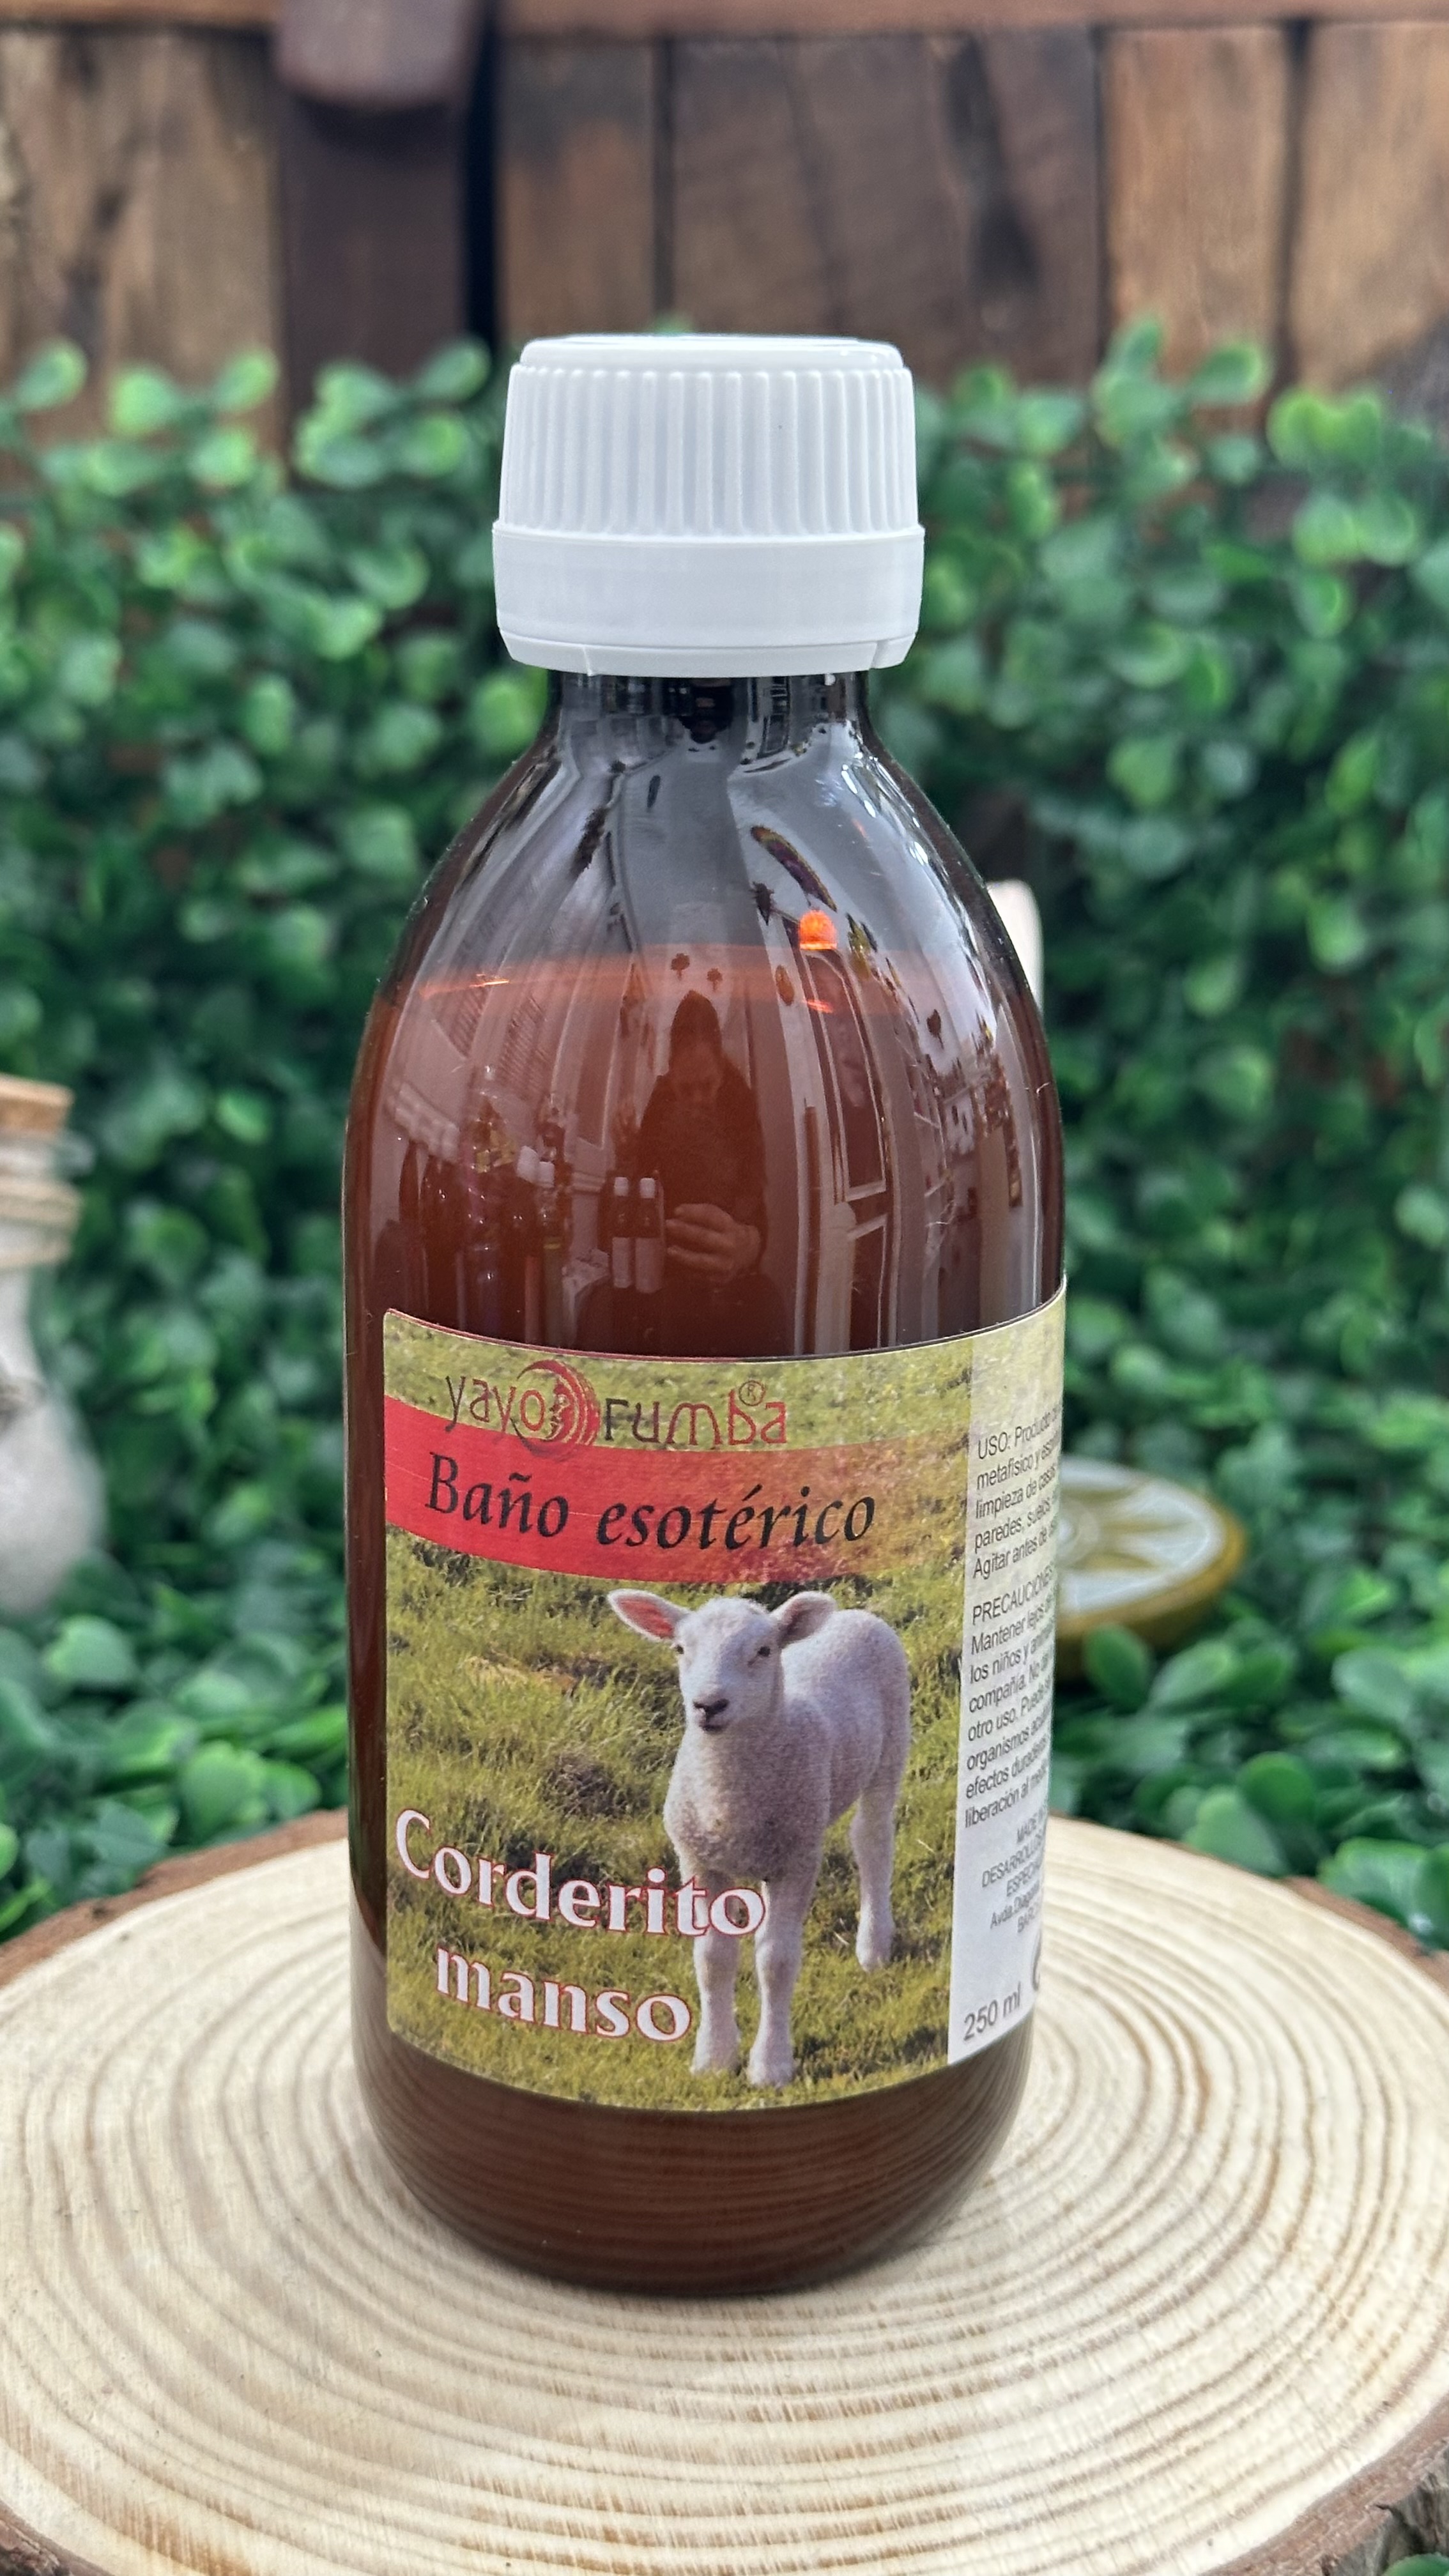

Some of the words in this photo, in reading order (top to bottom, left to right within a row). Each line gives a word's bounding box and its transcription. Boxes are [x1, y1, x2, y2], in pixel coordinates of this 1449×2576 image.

[978, 1432, 1011, 1460] USO:
[424, 1451, 569, 1537] Baño
[597, 1483, 876, 1550] esotérico
[975, 1487, 1023, 1519] limpieza
[972, 1549, 1011, 1580] Agitar
[970, 1616, 1026, 1655] Mantener
[970, 1662, 989, 1684] los
[992, 1648, 1022, 1676] niños
[967, 1726, 1029, 1771] organismos
[968, 1720, 993, 1742] otro
[965, 1767, 1009, 1799] efectos
[965, 1788, 1020, 1828] liberación
[395, 1808, 766, 1936] Corderito
[435, 1945, 691, 2042] manso
[963, 1999, 999, 2041] 250
[1003, 1980, 1021, 2018] ml
